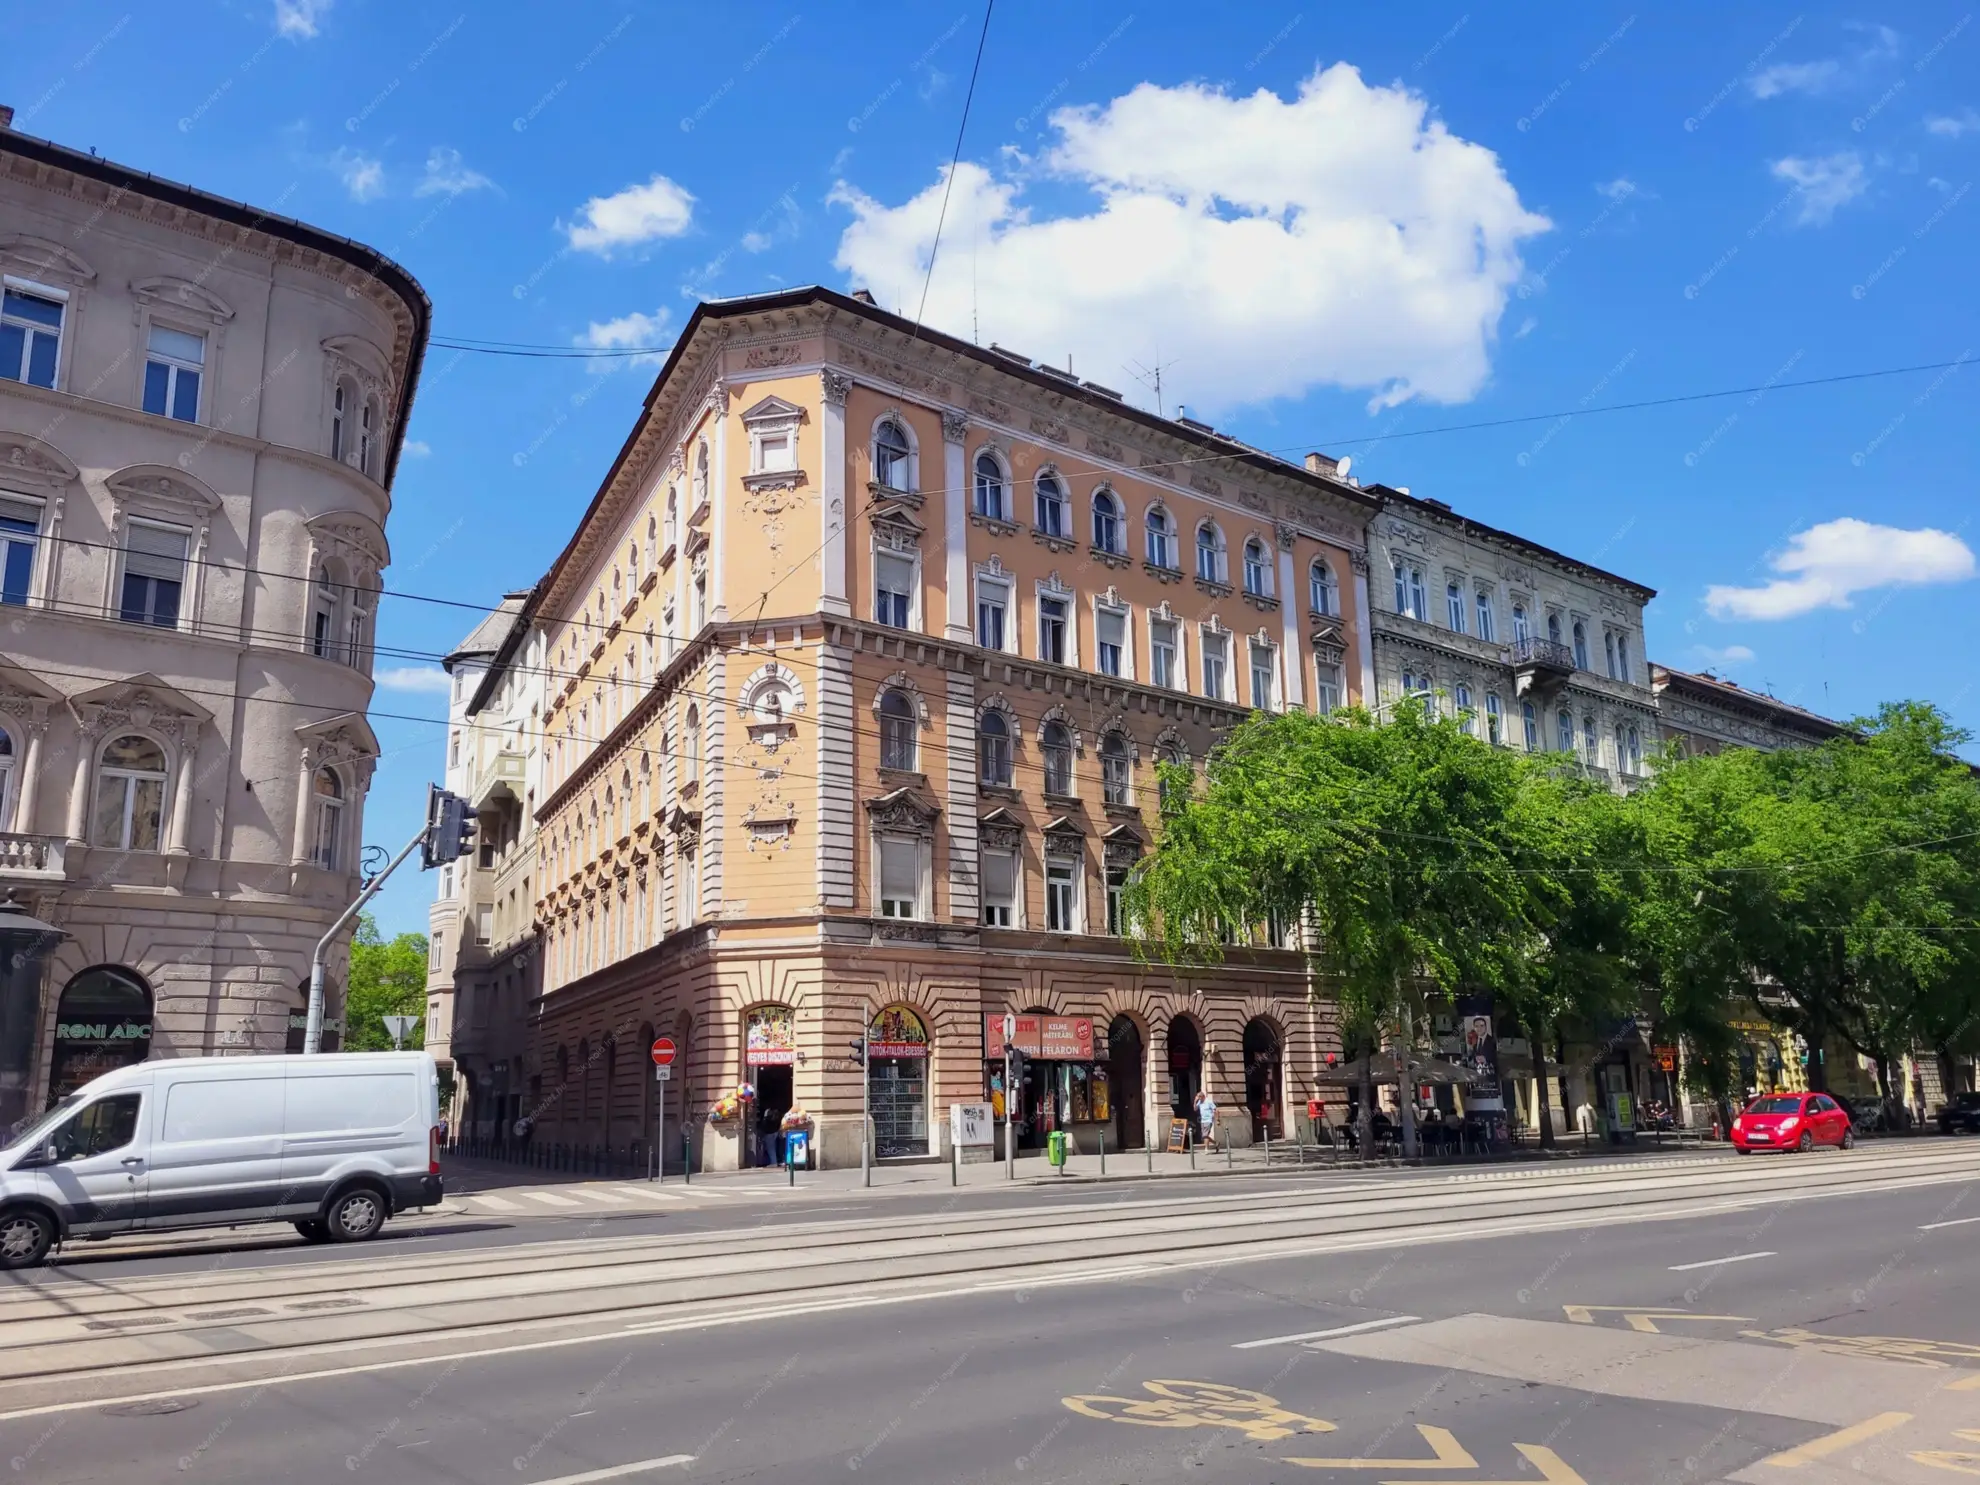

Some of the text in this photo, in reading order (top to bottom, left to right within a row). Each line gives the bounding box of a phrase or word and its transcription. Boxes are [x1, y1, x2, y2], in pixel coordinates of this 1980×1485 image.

[56, 1023, 151, 1039] RONI ABC
[1042, 1044, 1079, 1055] FÉLÁRON
